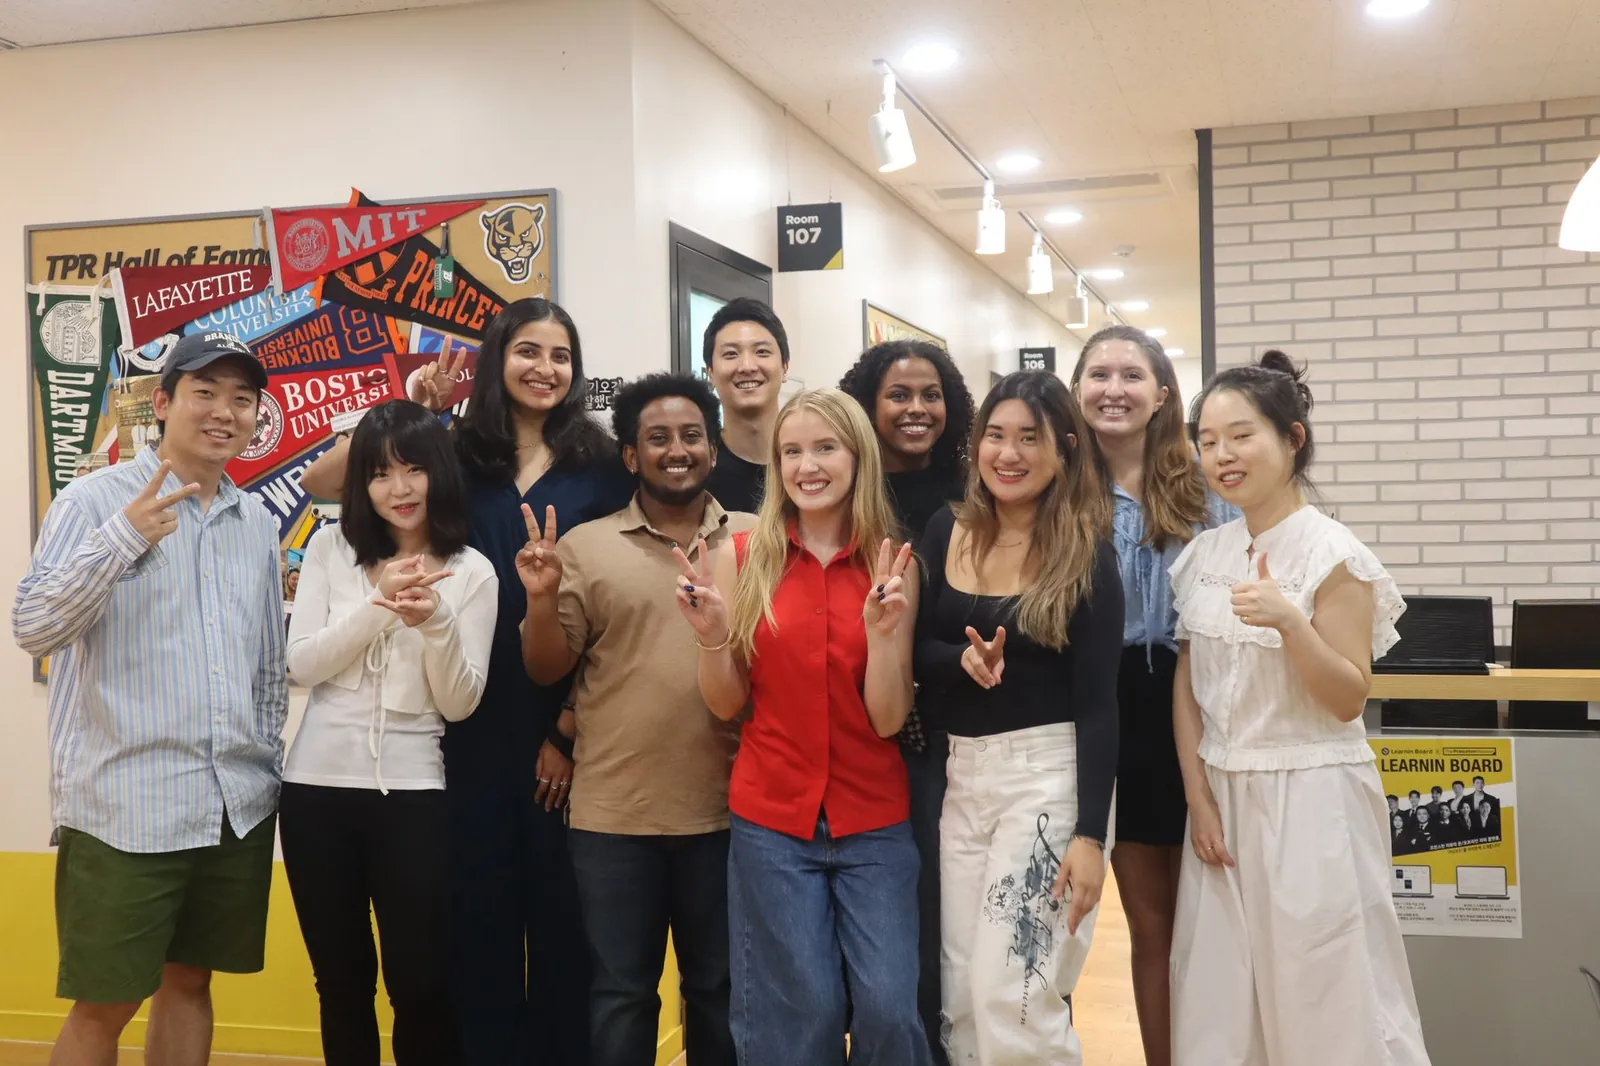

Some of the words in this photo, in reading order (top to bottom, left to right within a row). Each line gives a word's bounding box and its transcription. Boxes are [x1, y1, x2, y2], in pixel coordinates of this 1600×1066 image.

[331, 208, 427, 259] MIT
[785, 215, 819, 225] Room
[786, 227, 822, 245] 107
[46, 253, 97, 280] TPR
[102, 248, 160, 277] Hall
[166, 245, 198, 266] of
[133, 269, 254, 319] LAFAYETTE
[204, 332, 251, 354] BRAND
[1024, 360, 1046, 370] 106
[290, 383, 391, 440] UNIVERSI
[47, 369, 95, 488] DARTMOU
[1381, 758, 1445, 773] LEARNIN
[1450, 758, 1503, 773] BOARD
